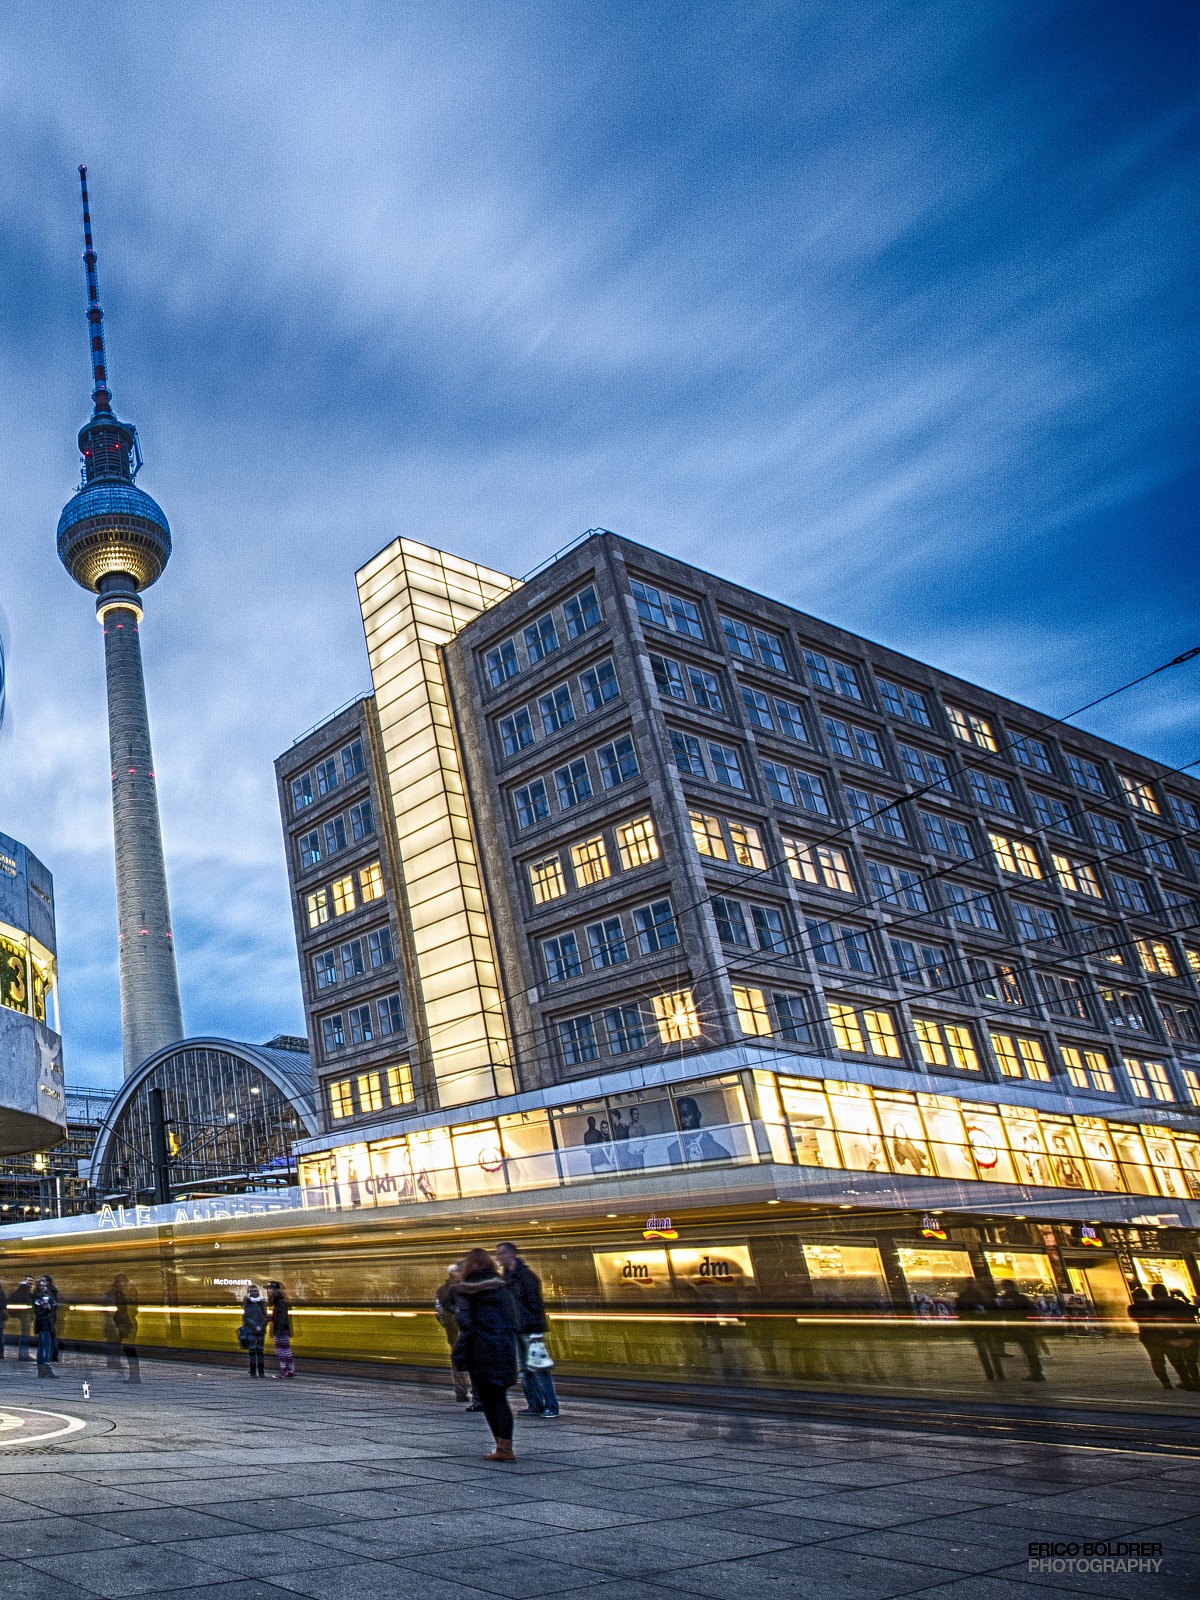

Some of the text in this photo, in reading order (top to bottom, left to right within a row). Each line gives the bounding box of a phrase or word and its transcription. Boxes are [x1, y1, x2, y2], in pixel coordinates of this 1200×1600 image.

[8, 956, 25, 1002] 3
[646, 1214, 672, 1230] dm
[622, 1261, 649, 1278] dm
[700, 1257, 729, 1276] dm
[214, 1278, 252, 1286] McDonald's
